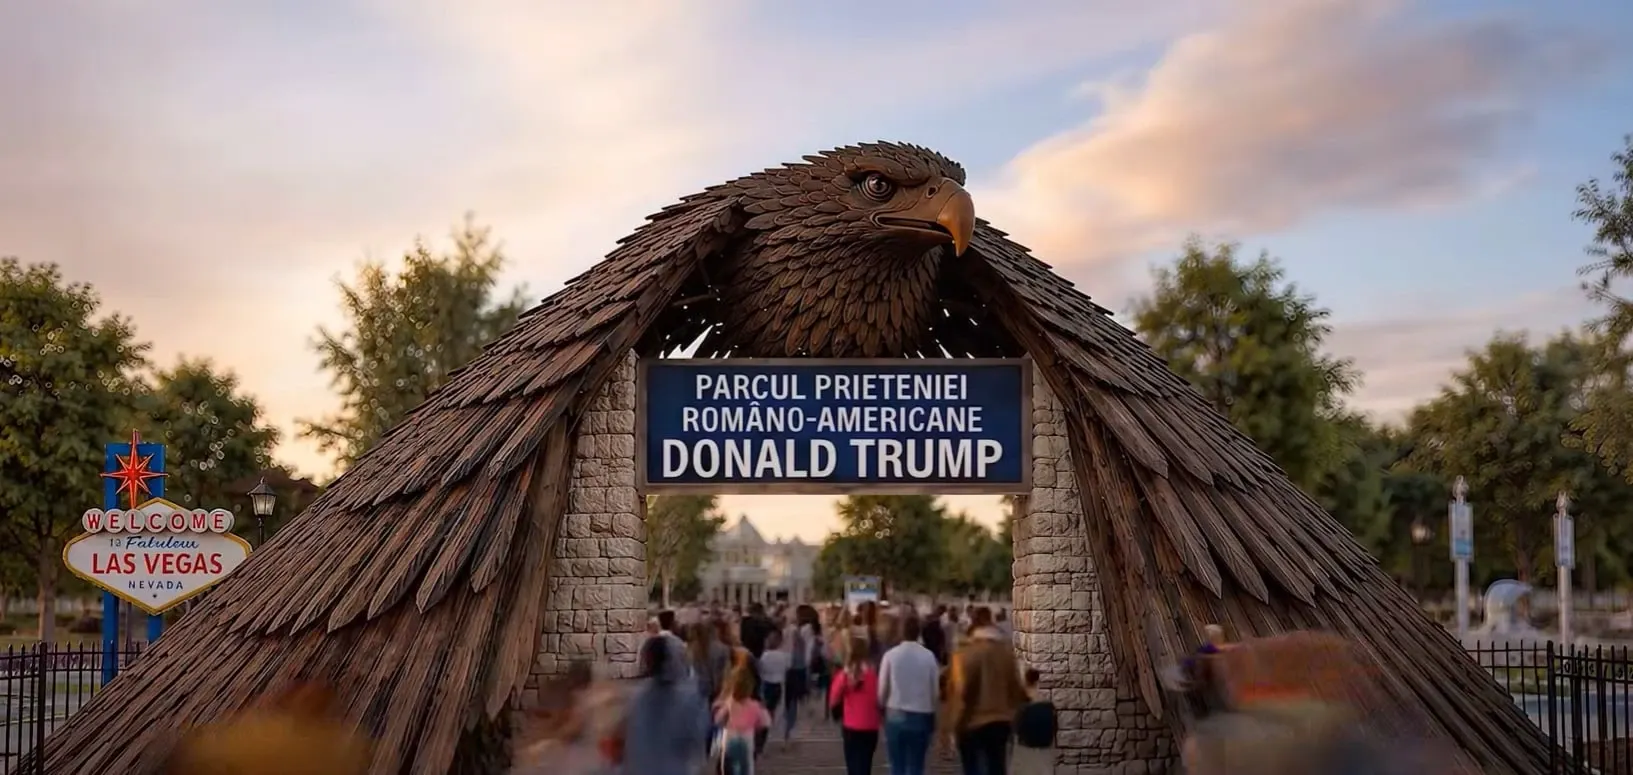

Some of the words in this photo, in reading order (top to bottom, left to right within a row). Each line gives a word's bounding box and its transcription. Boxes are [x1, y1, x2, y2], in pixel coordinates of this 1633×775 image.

[695, 374, 806, 400] PARCUL
[815, 374, 967, 400] PRIETENIEI
[682, 401, 983, 433] ROMÂNO-AMERICANE
[662, 438, 838, 479] DONALD
[850, 438, 1004, 479] TRUMP
[87, 513, 225, 529] WELCOME
[92, 553, 136, 574] LAS
[144, 553, 223, 574] VEGAS
[128, 580, 184, 590] NEVADA
